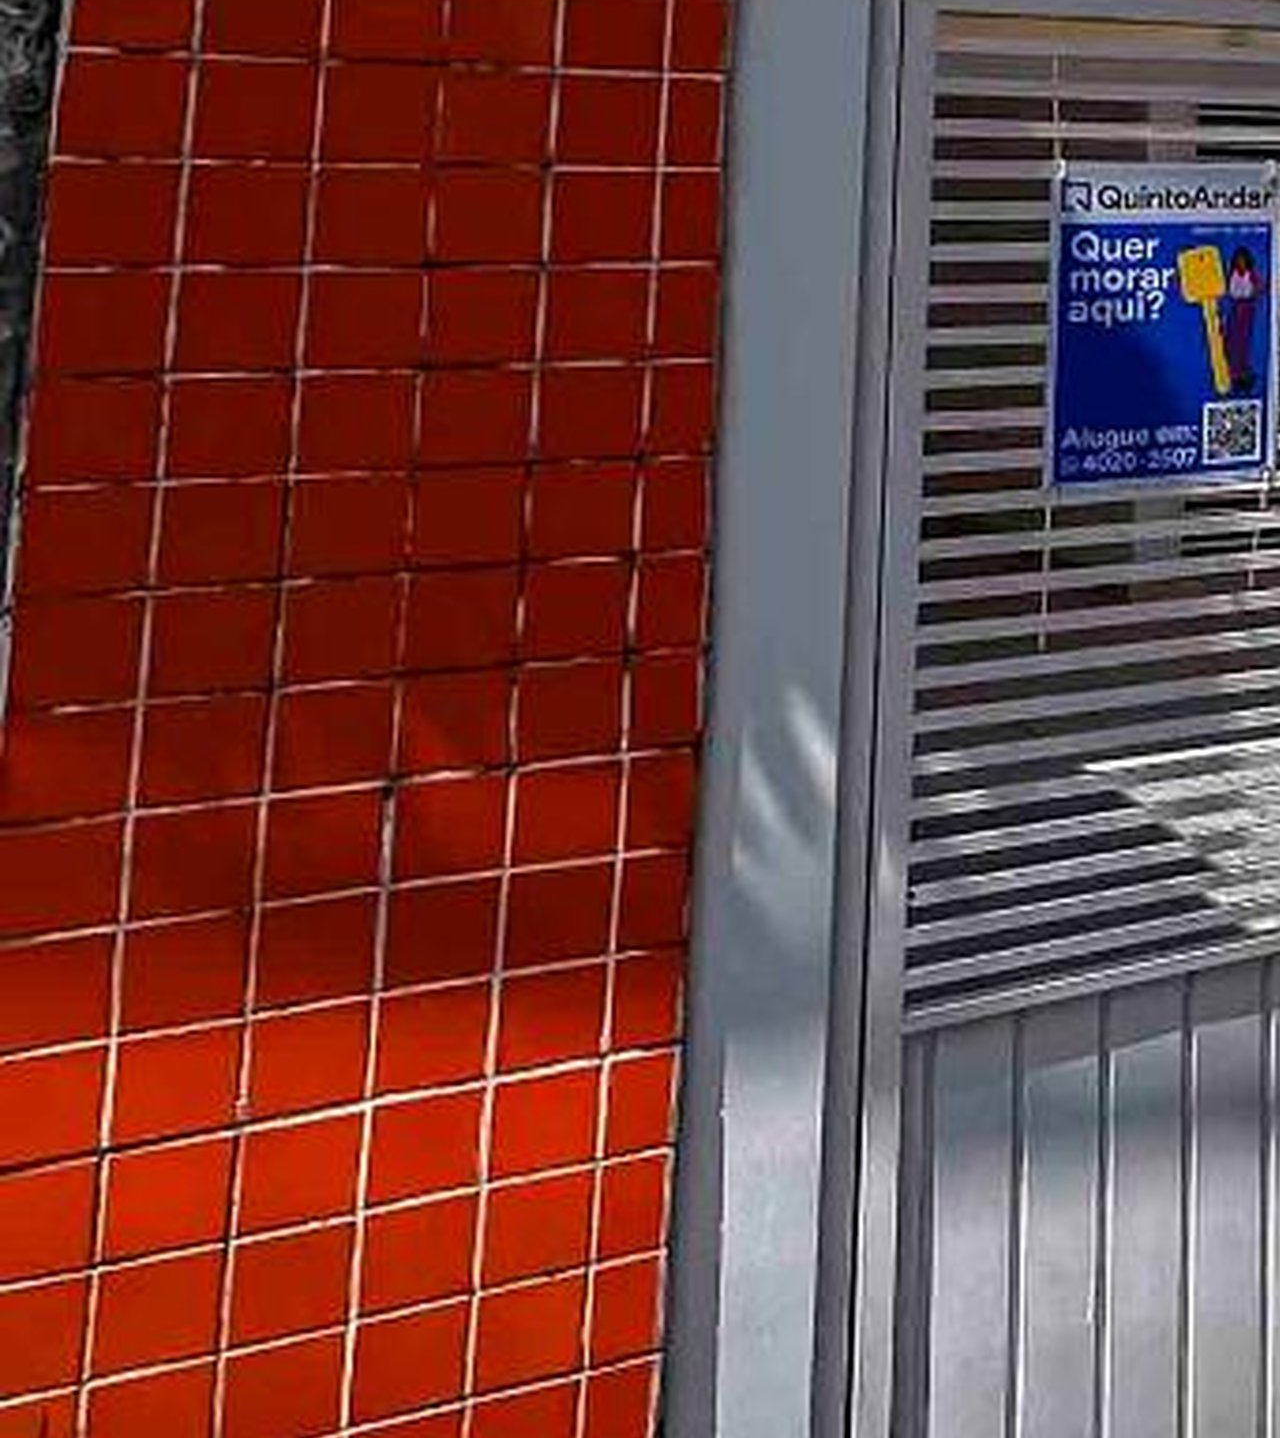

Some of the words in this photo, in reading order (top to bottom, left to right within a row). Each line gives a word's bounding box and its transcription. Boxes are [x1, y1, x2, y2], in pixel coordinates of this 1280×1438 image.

[1098, 184, 1273, 209] QuintoAndar
[1071, 230, 1159, 262] Quer
[1070, 268, 1175, 291] morar
[1067, 290, 1165, 328] aqui?
